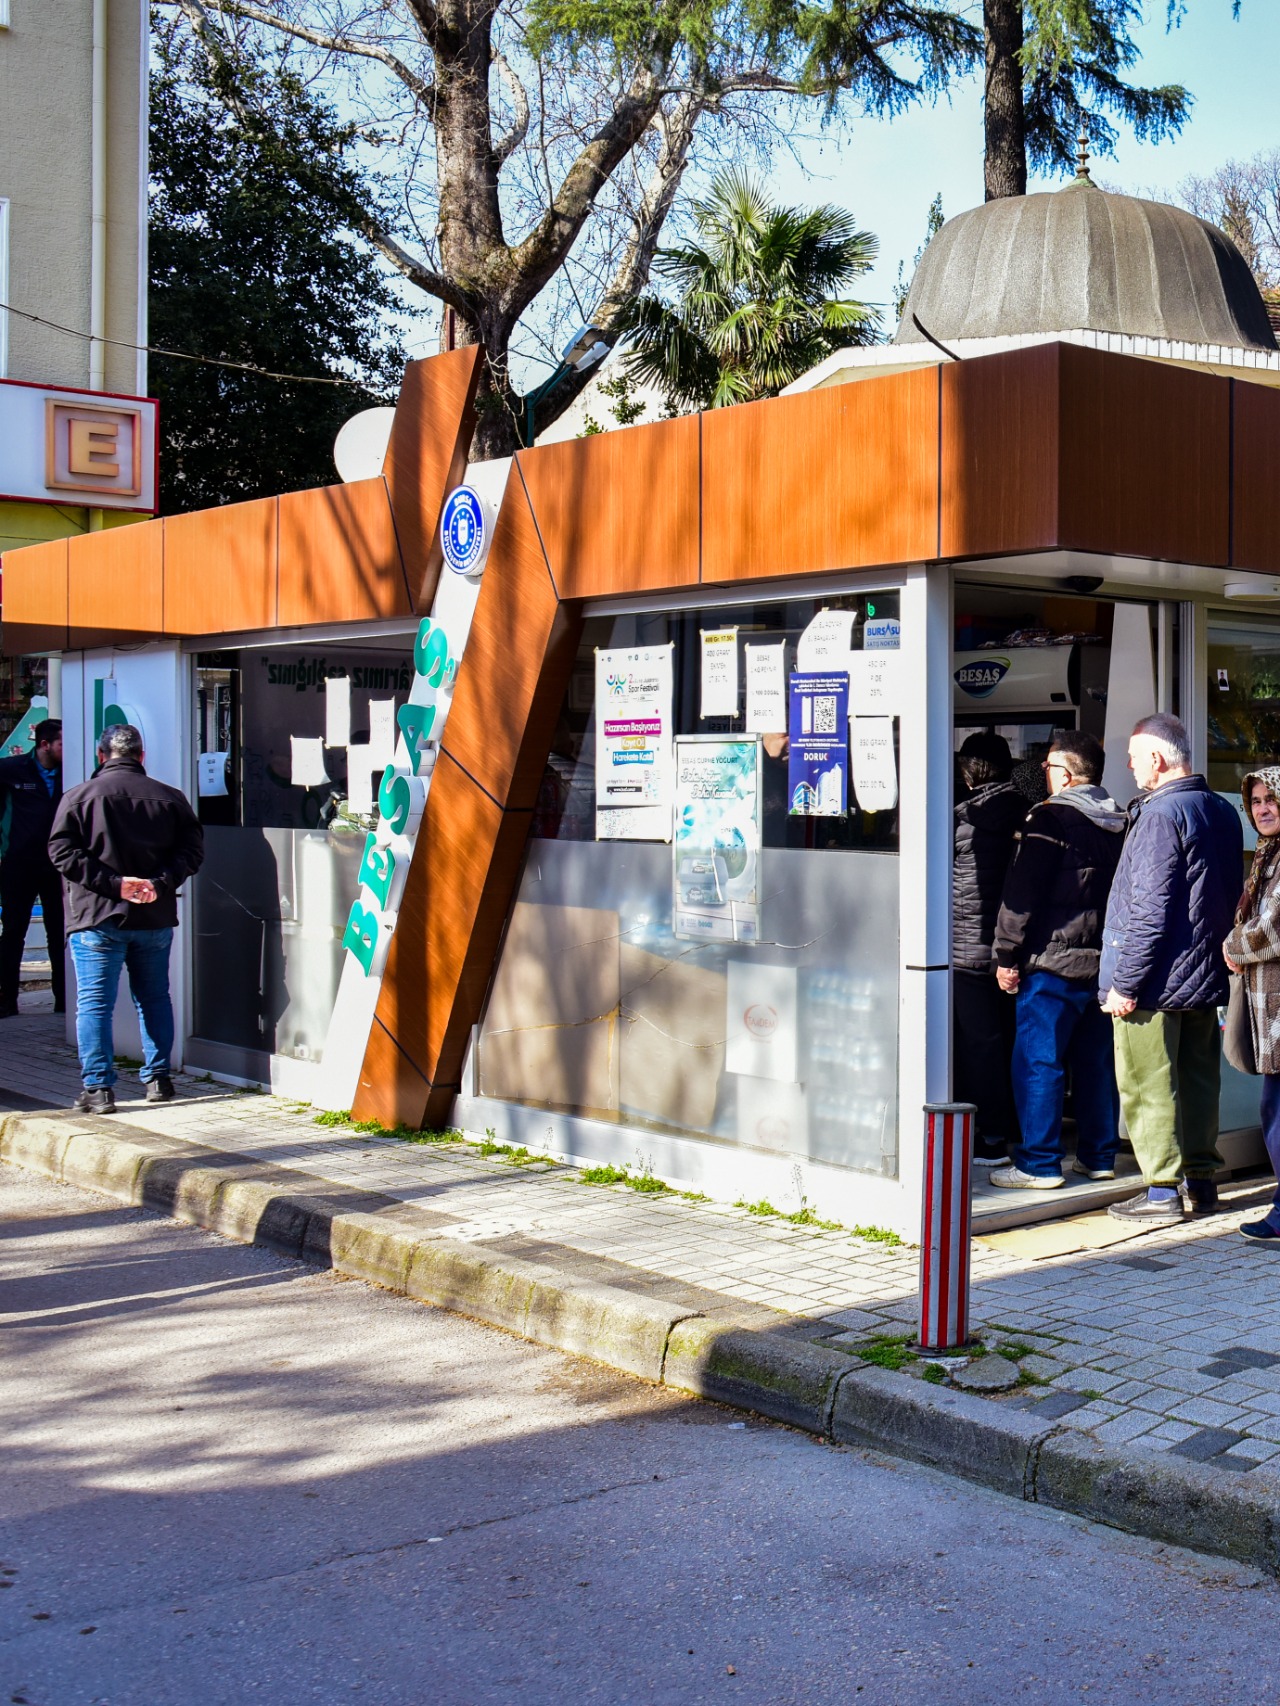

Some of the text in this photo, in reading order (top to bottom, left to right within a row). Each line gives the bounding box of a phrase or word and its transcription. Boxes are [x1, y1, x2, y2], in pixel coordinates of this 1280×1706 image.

[68, 418, 119, 477] E
[880, 639, 900, 647] NOKTAS
[959, 668, 1000, 683] BESAŞ
[343, 617, 456, 978] BESAŞ
